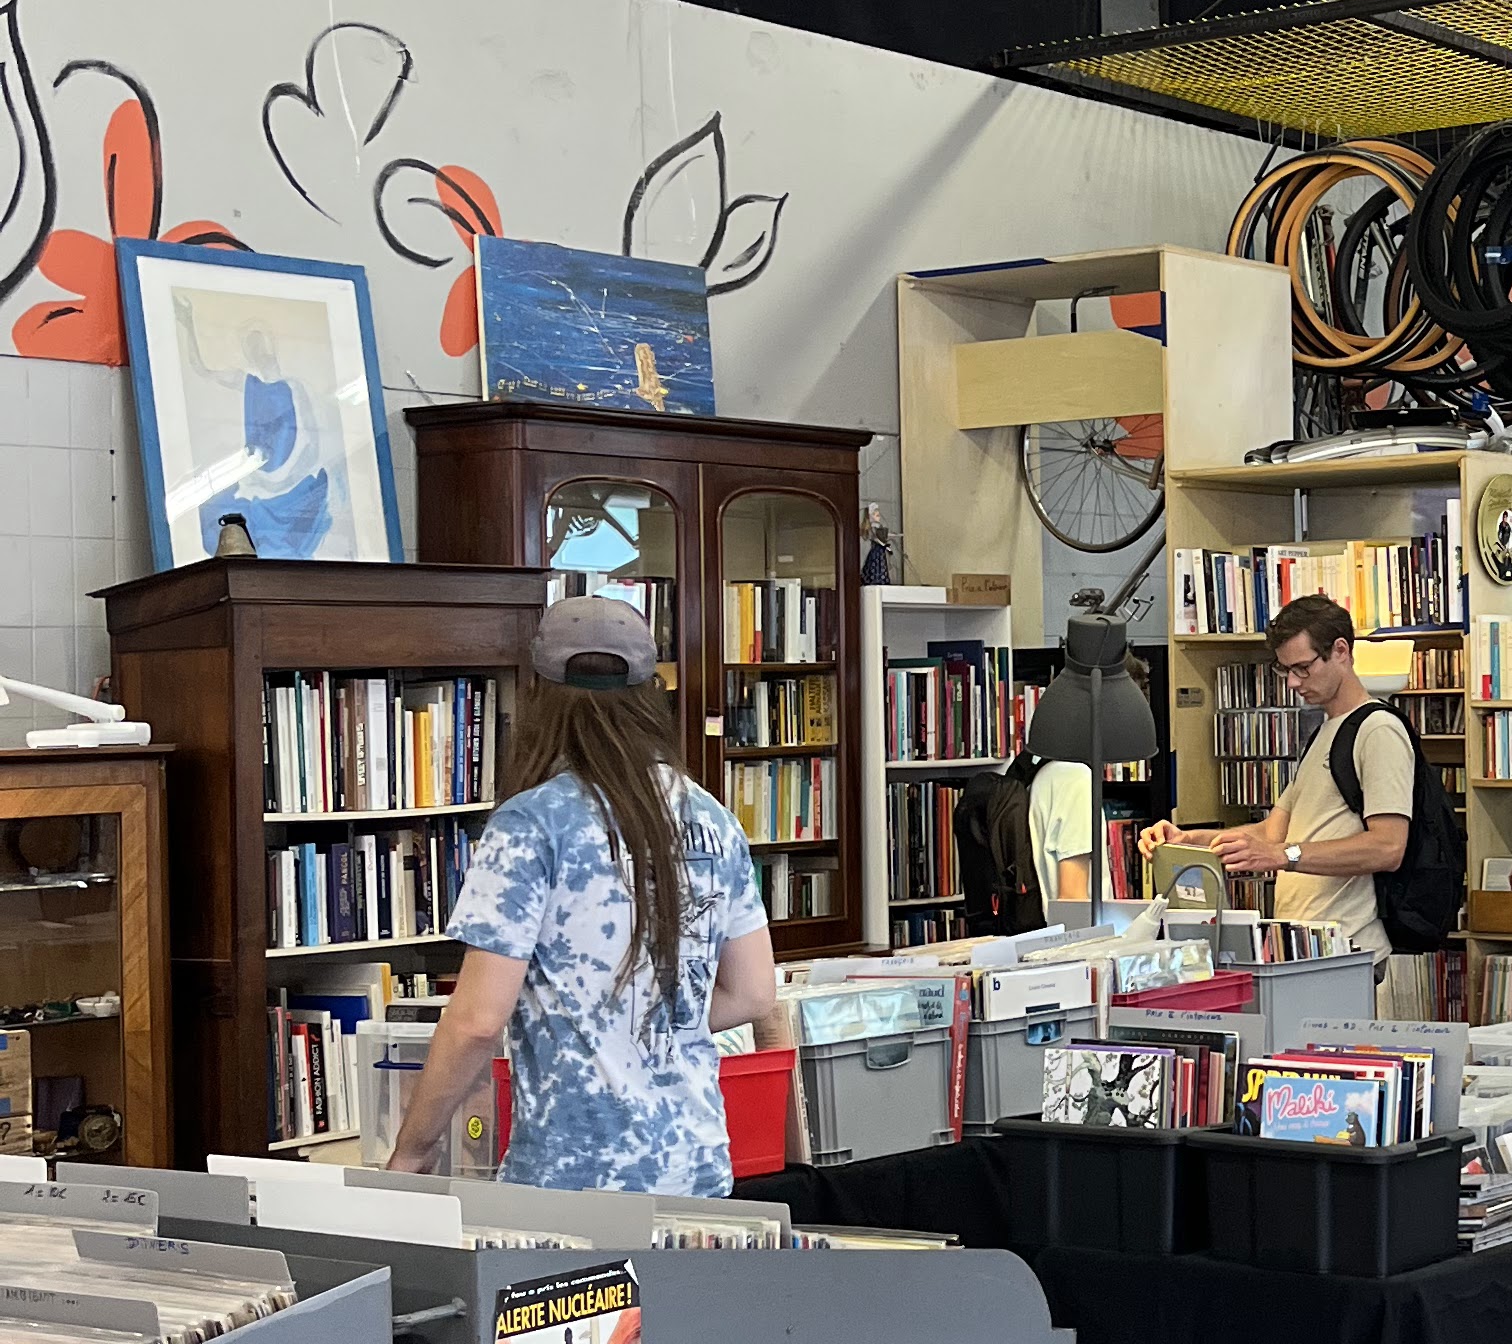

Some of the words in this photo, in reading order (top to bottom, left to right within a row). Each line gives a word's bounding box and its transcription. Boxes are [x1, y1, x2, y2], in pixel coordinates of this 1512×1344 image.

[311, 1044, 321, 1077] ADDICT
[314, 1077, 324, 1115] FASHION
[1266, 1083, 1339, 1125] Maliki
[126, 1237, 191, 1256] DIVERS
[496, 1301, 546, 1335] ALERTE
[548, 1283, 626, 1324] NUCLÉAIRE
[626, 1282, 633, 1305] !
